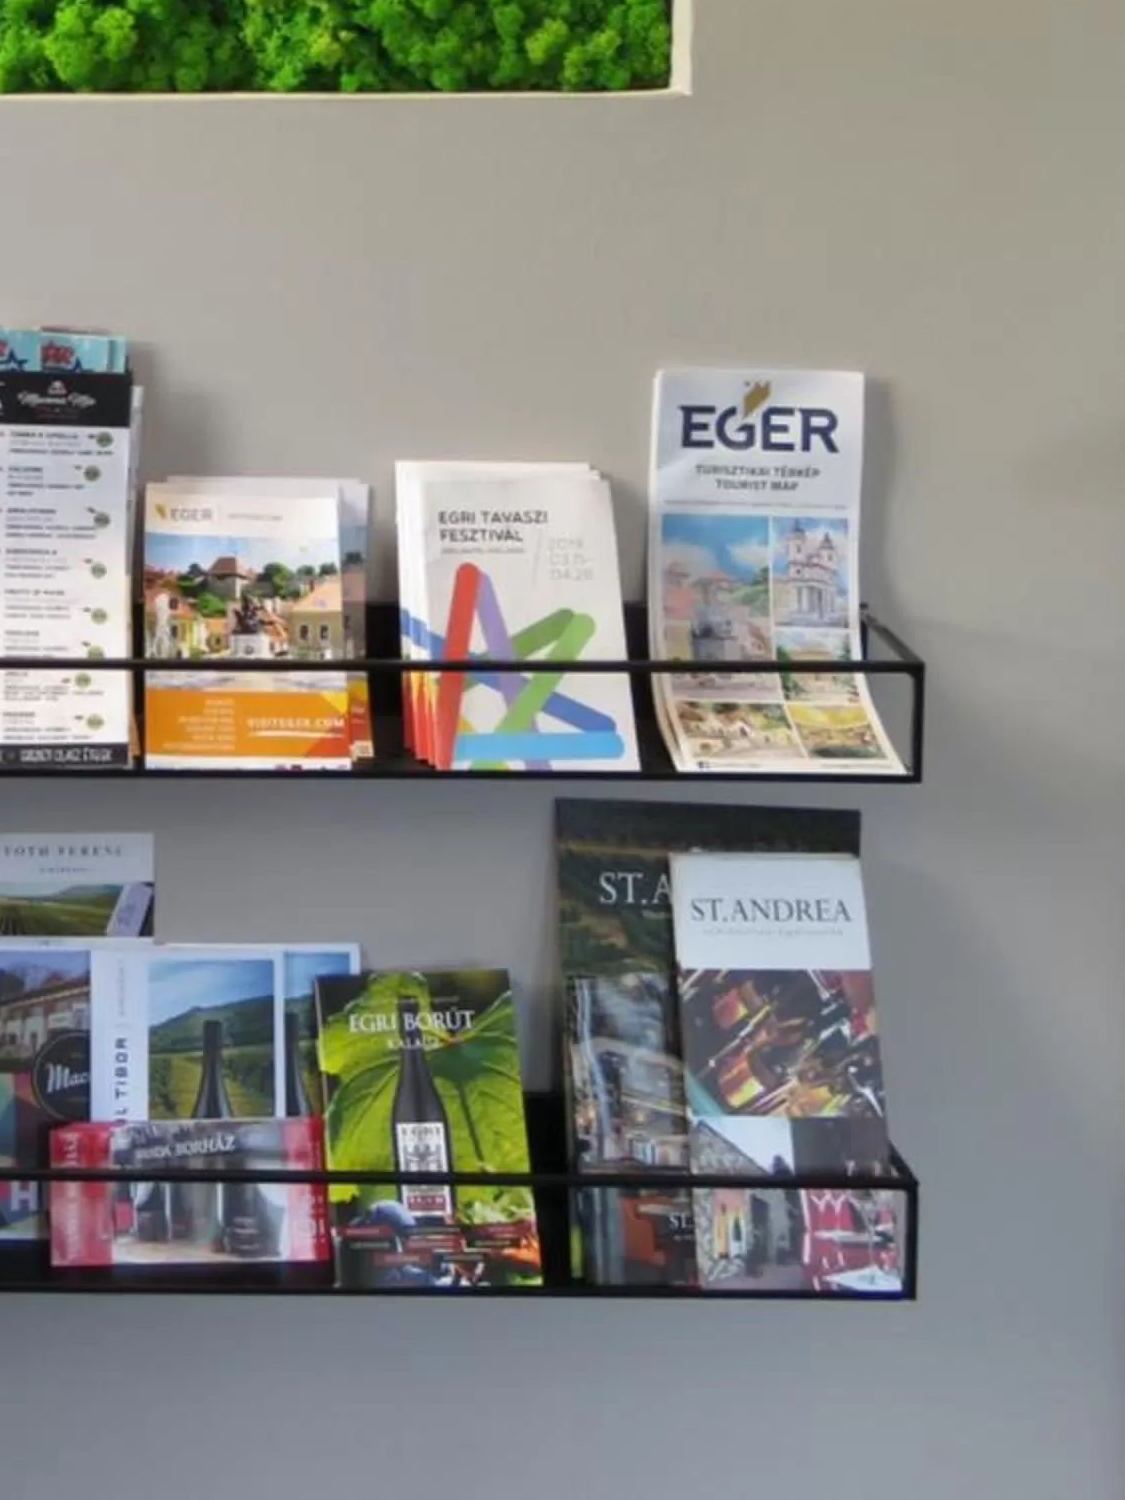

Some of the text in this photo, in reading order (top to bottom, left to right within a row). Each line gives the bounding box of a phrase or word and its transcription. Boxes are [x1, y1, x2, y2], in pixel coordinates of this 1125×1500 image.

[678, 404, 840, 454] EGER
[715, 479, 799, 491] TOURIST MAP
[437, 509, 548, 525] EGRI TAVASZI
[690, 897, 853, 923] ST.ANDREA
[348, 1006, 476, 1033] EGRI BORÚT
[115, 1037, 129, 1100] TIBOR
